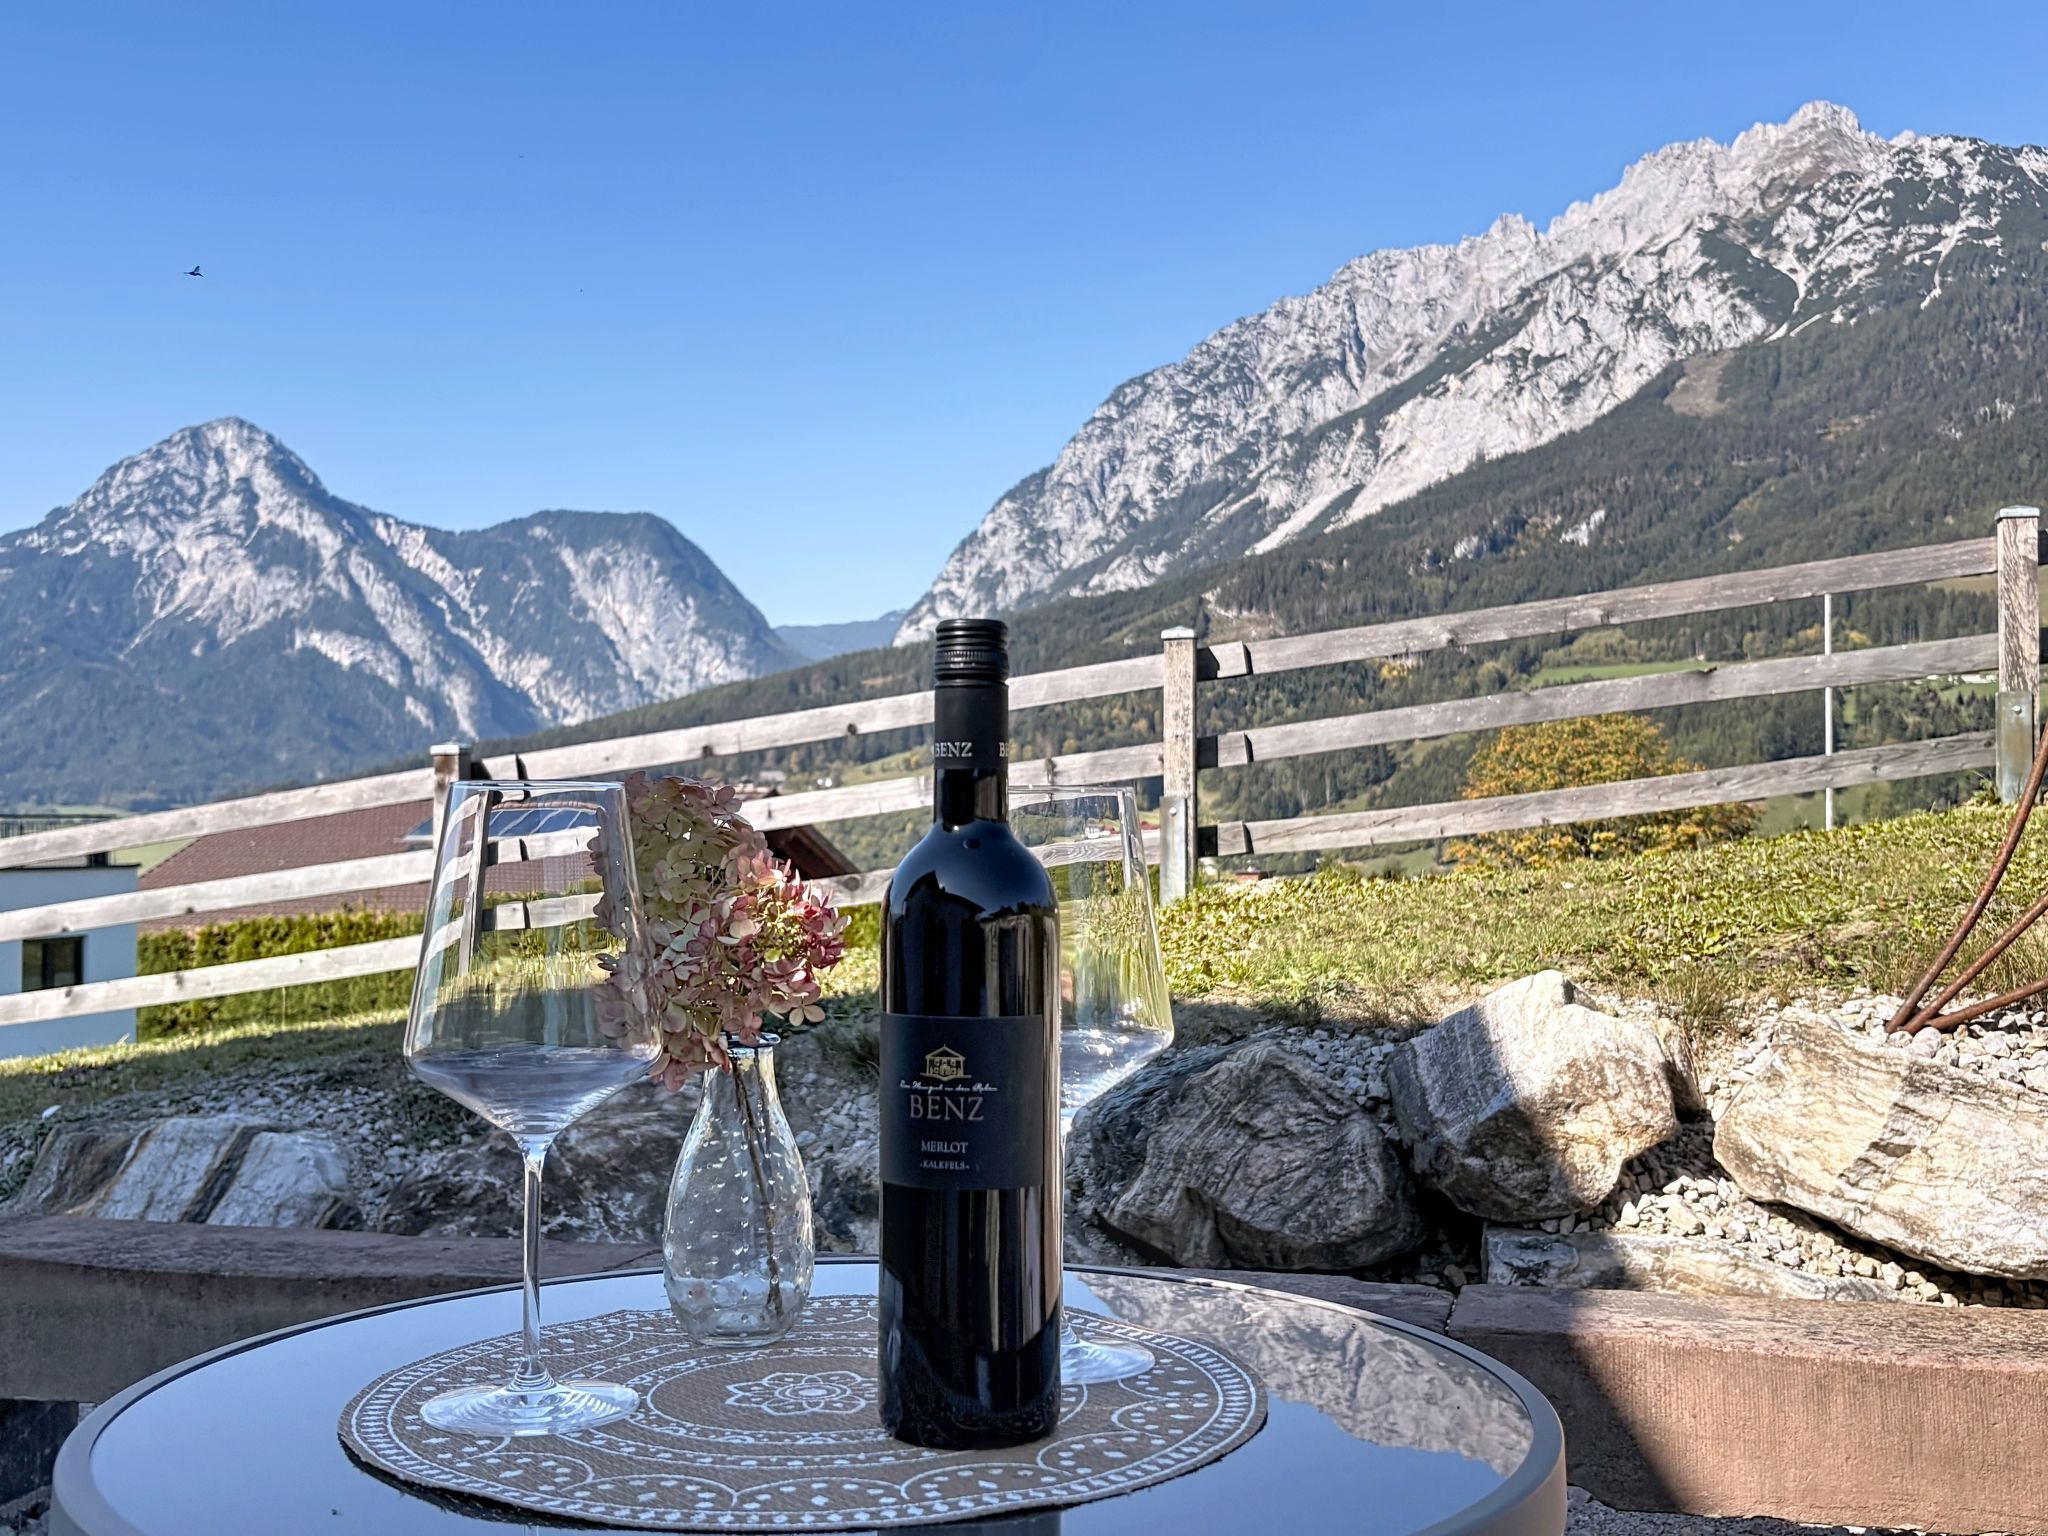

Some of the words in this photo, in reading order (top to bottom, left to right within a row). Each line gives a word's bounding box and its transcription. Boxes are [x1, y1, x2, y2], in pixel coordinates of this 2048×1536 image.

[934, 741, 973, 758] BENZ
[910, 1094, 985, 1121] BENZ
[920, 1140, 969, 1154] MERLOT
